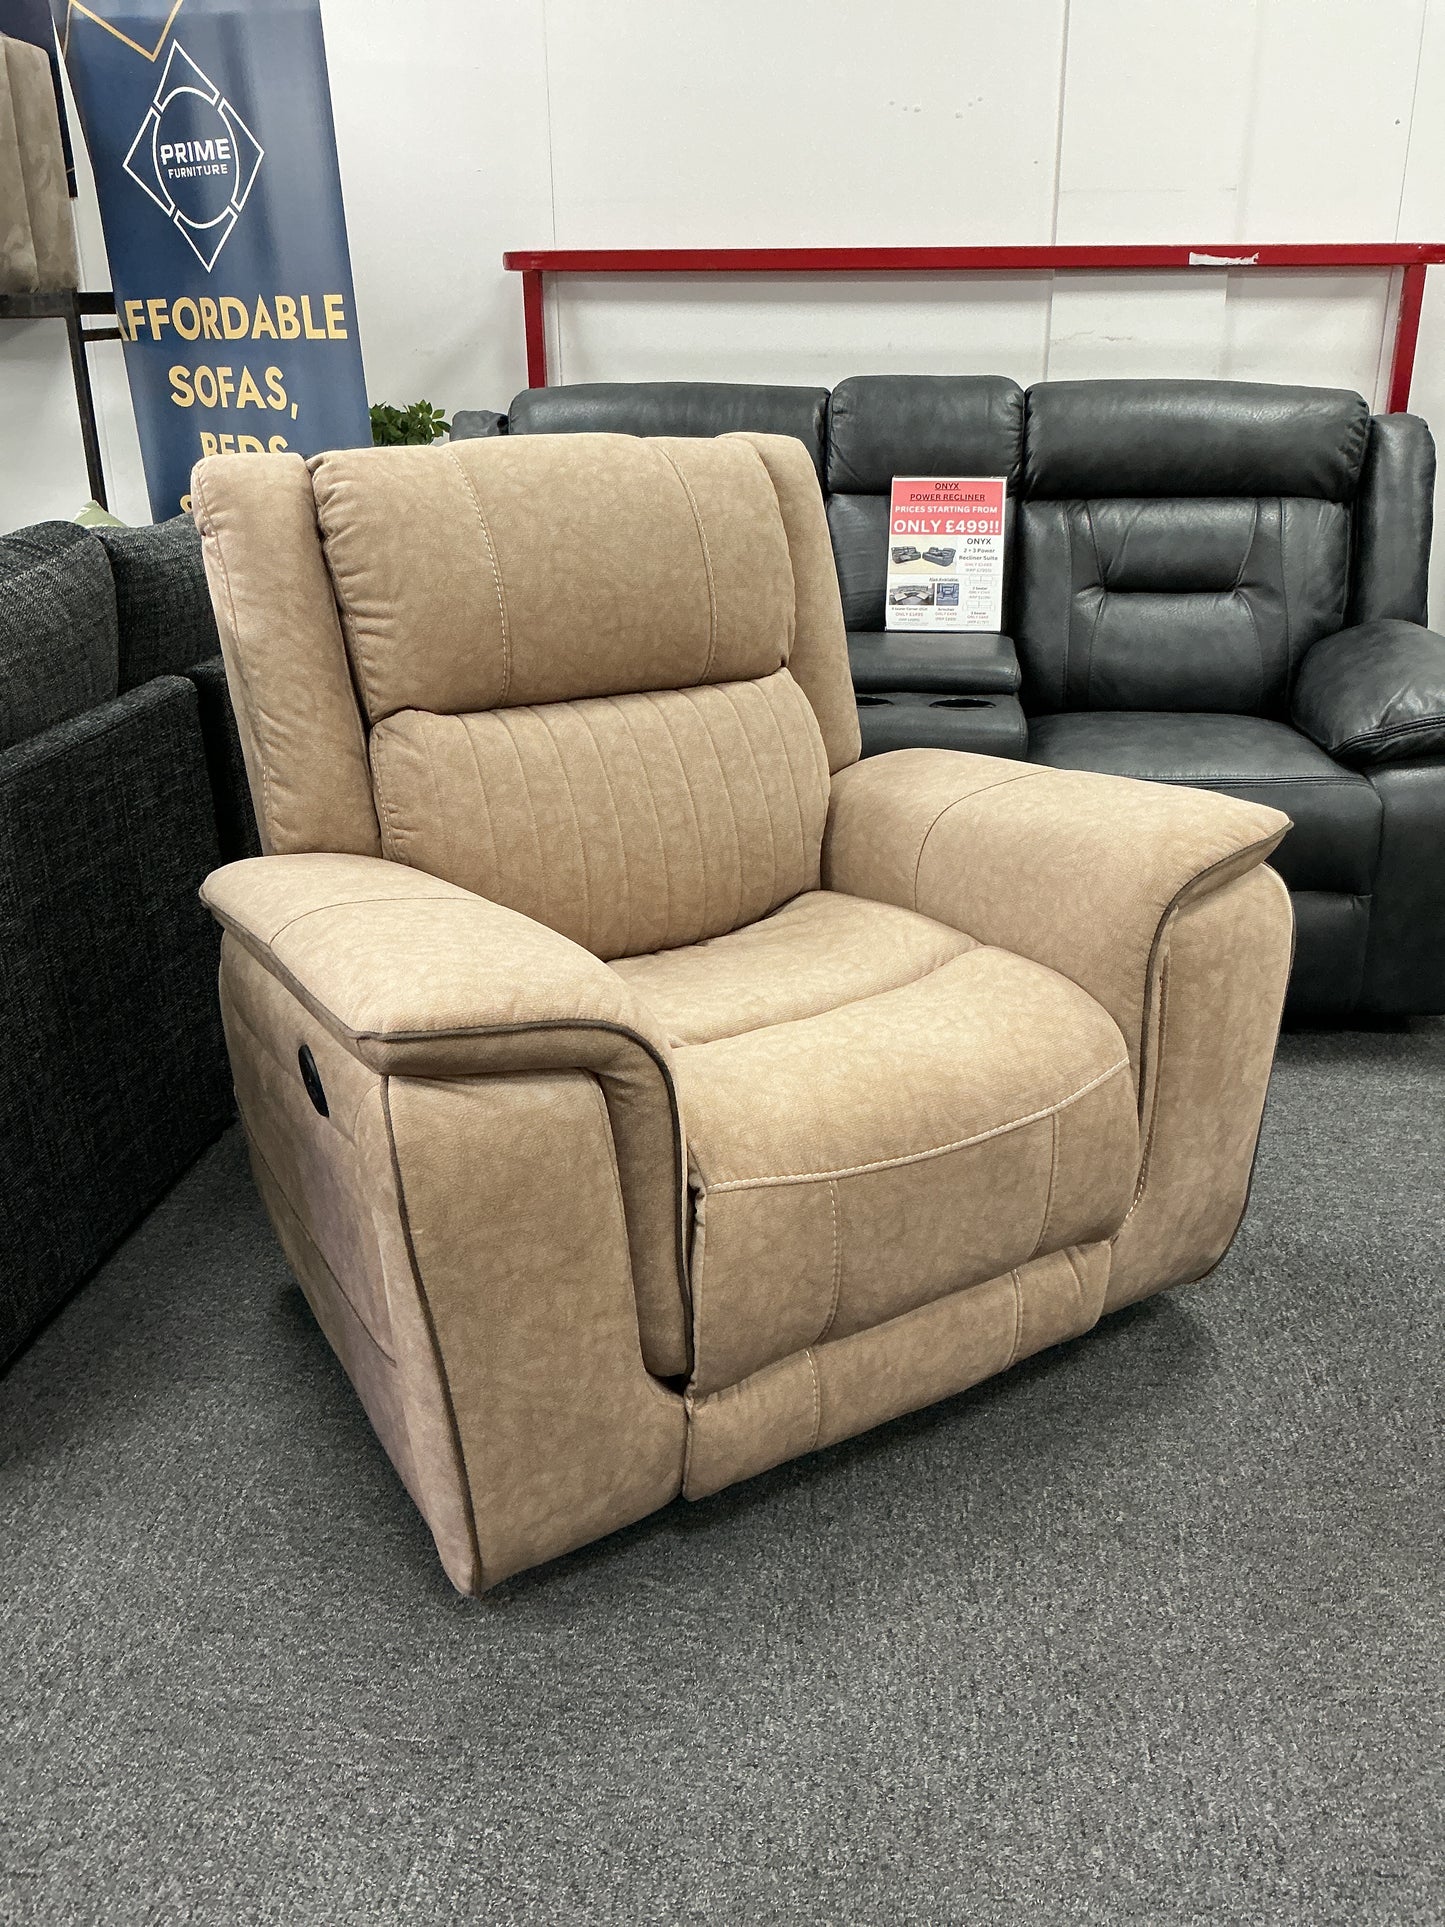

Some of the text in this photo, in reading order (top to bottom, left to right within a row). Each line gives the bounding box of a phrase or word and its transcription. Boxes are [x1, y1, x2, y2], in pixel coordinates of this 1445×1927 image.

[160, 138, 231, 165] PRIME
[168, 164, 228, 179] FURNITURE
[118, 294, 348, 342] FFORDABLE
[168, 364, 299, 420] SOFAS,
[935, 483, 960, 491] ONYX
[910, 493, 941, 501] POWER
[895, 505, 925, 513] PRICES
[927, 505, 970, 513] STARTING
[894, 519, 999, 533] ONLY £499!!
[966, 537, 992, 545] ONYX
